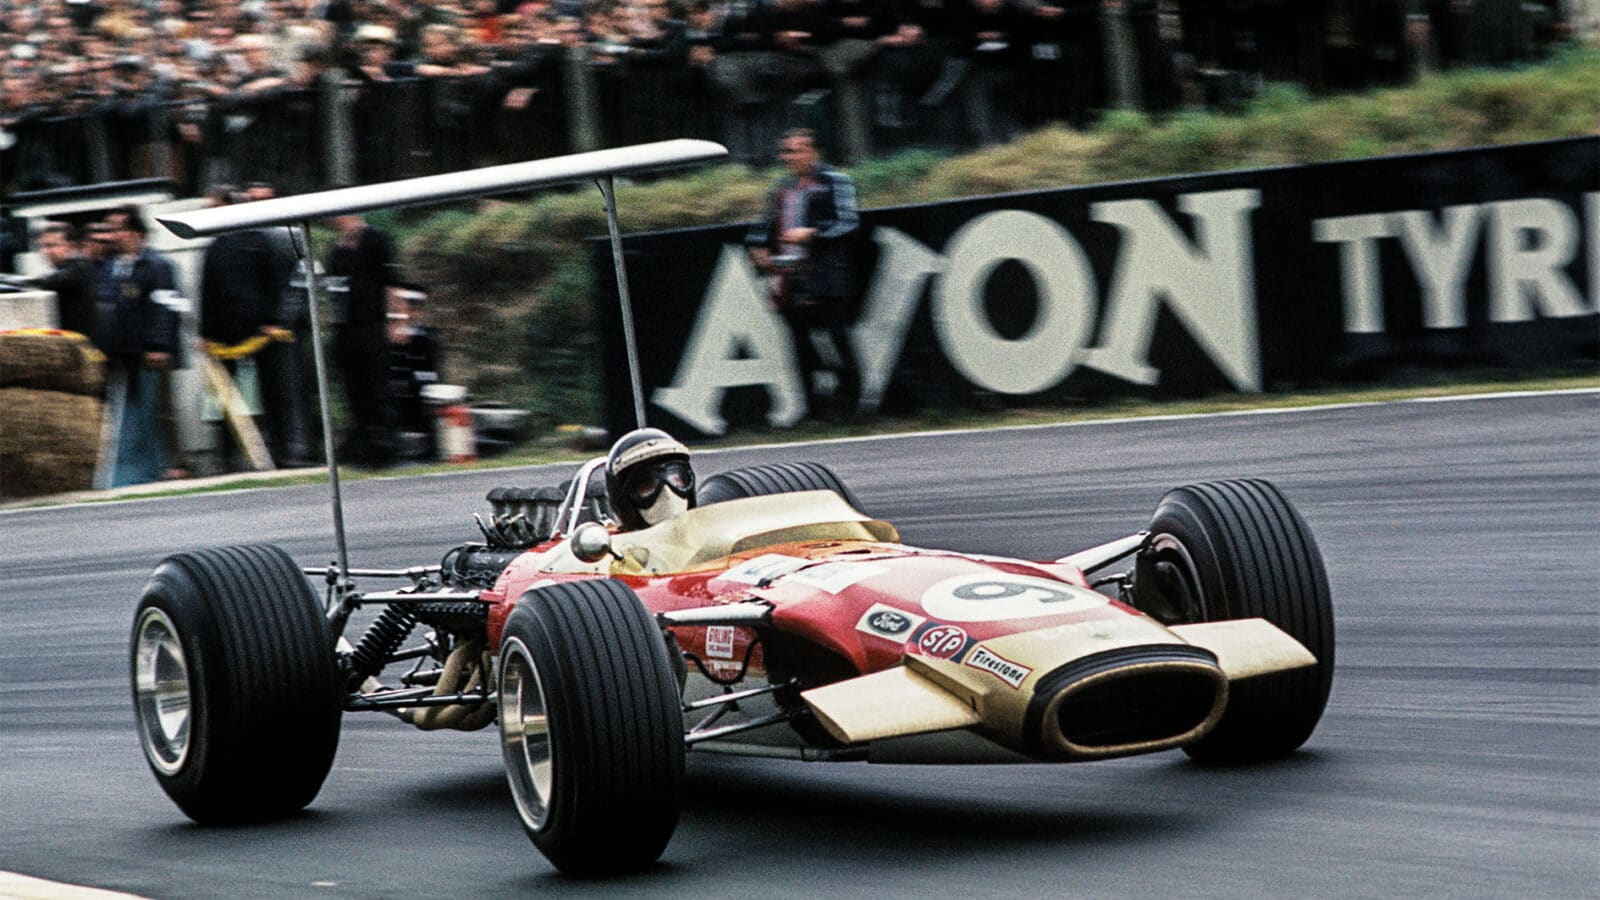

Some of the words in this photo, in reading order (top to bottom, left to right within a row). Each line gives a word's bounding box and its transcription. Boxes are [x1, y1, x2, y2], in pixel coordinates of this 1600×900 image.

[1312, 191, 1600, 333] TYR
[952, 581, 1075, 603] 9
[873, 613, 905, 631] Ford
[923, 627, 961, 654] STP
[972, 649, 1024, 682] Firestone
